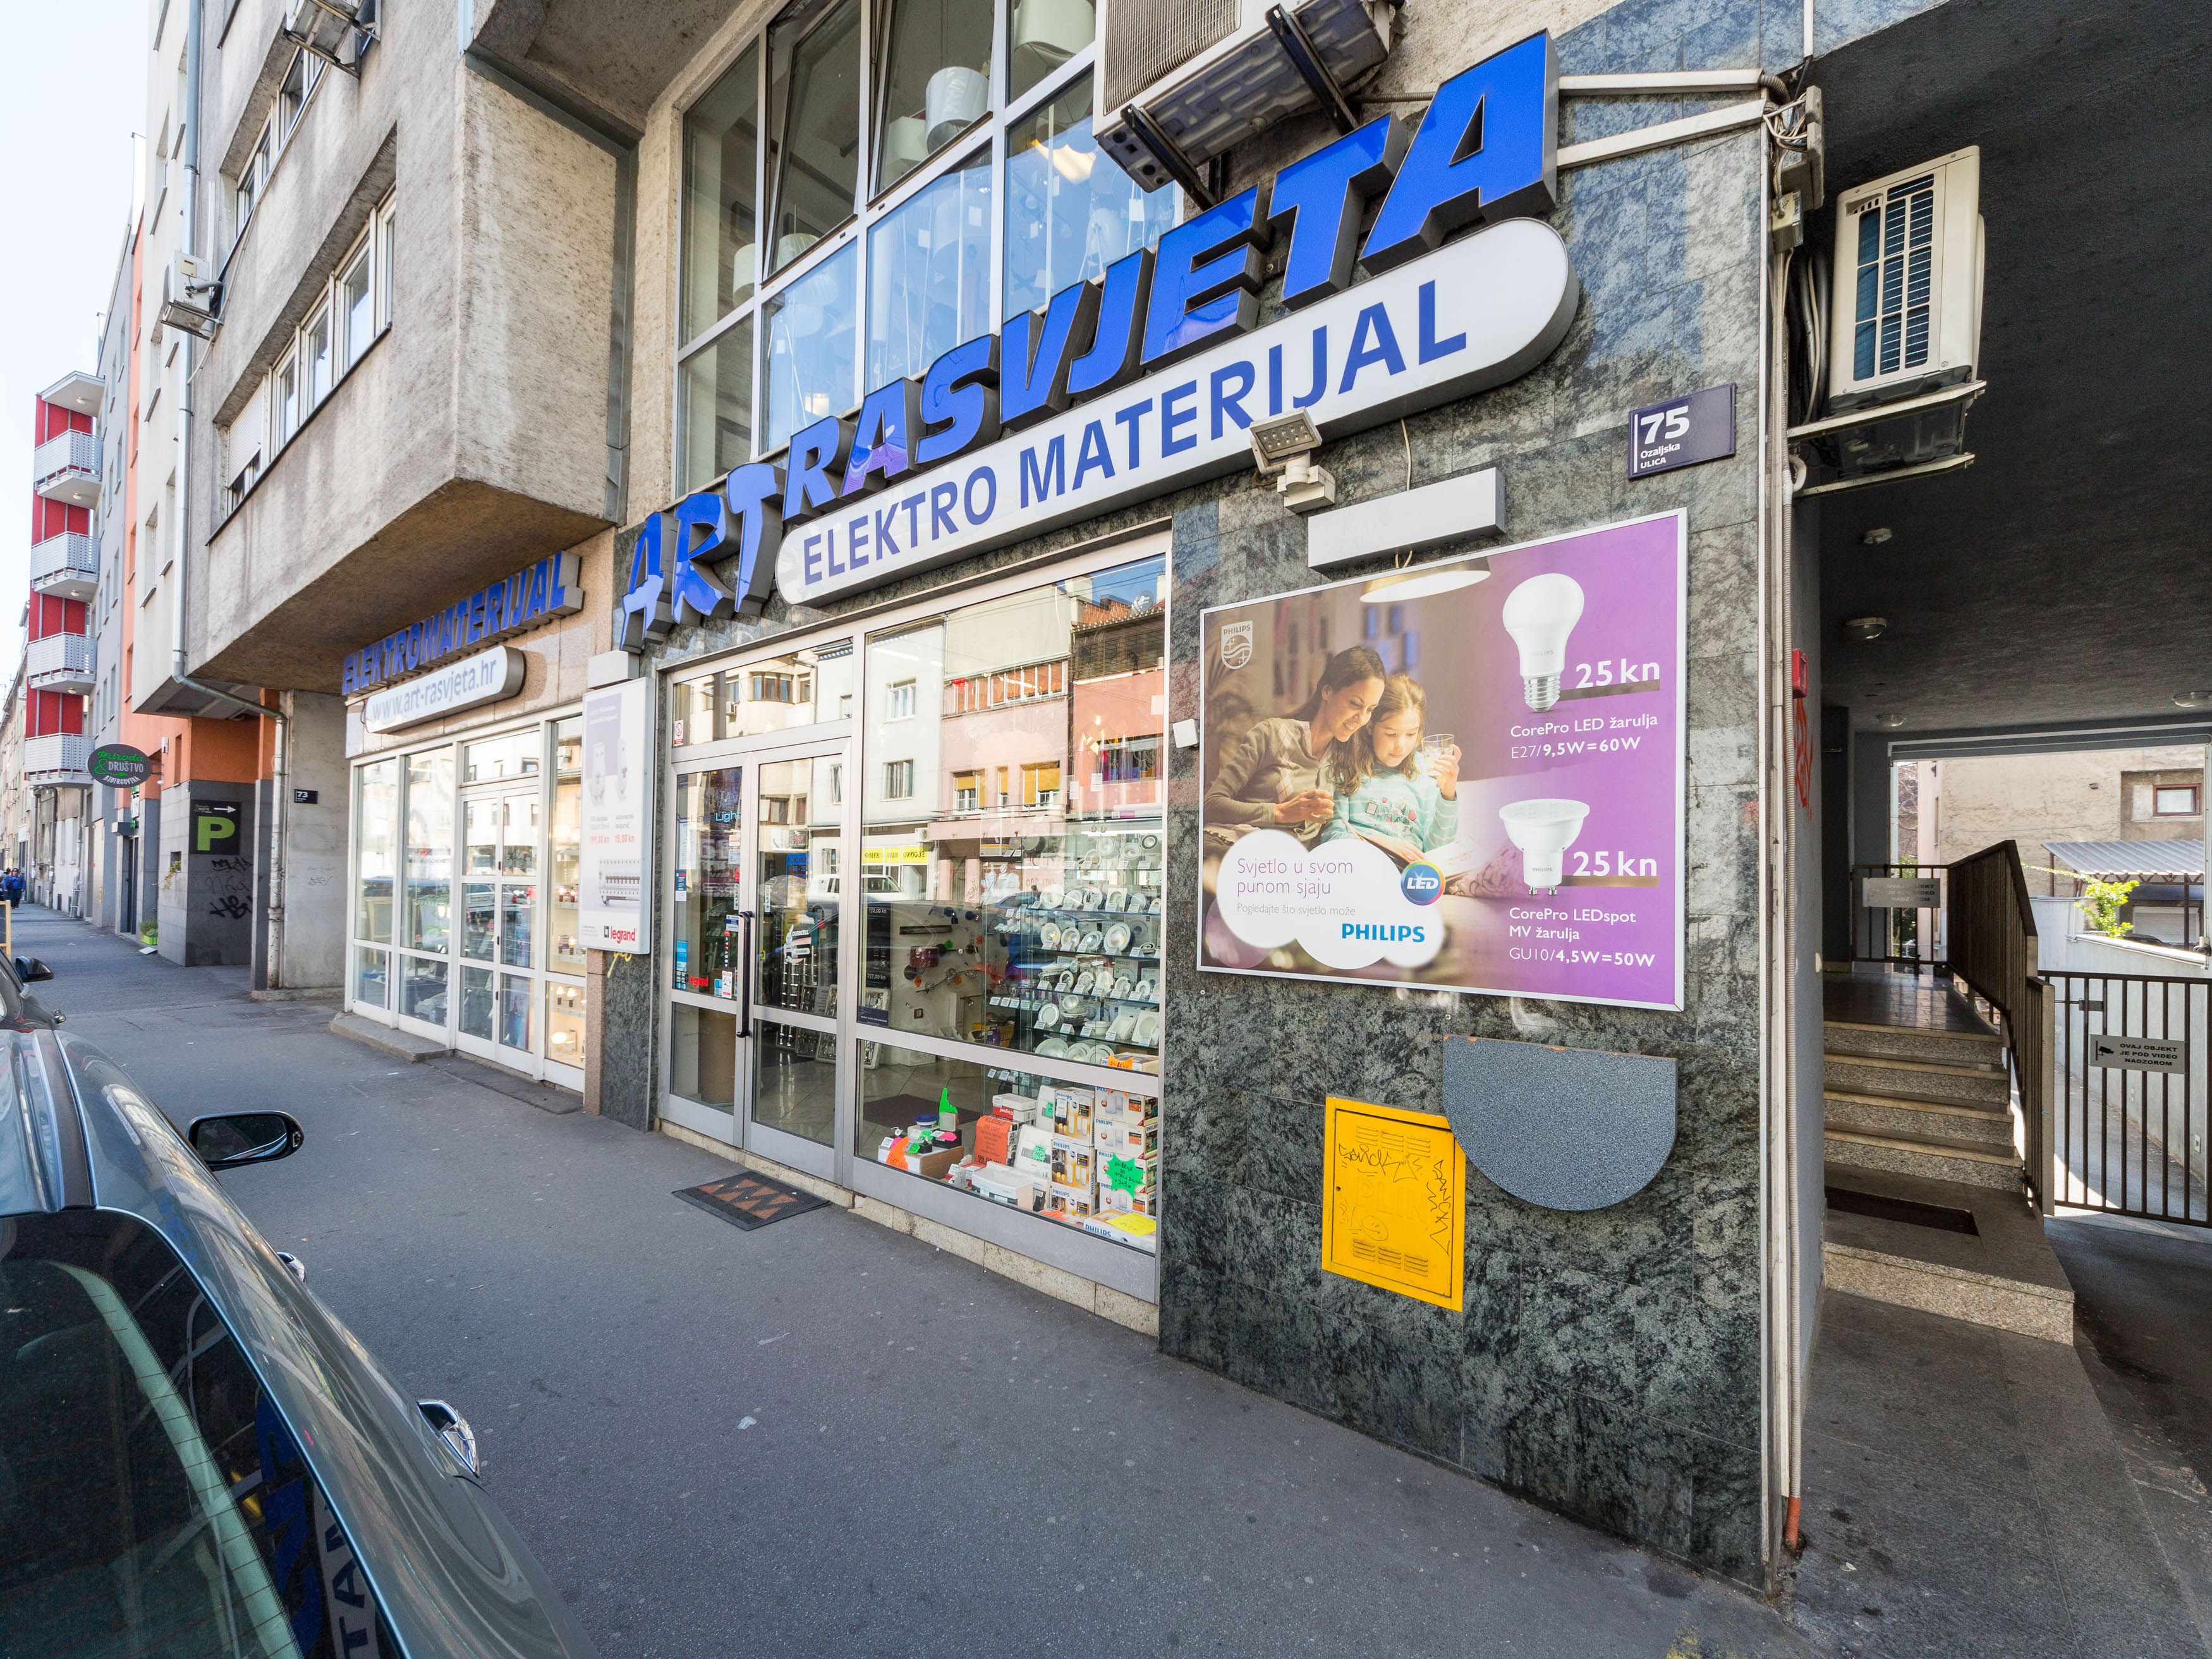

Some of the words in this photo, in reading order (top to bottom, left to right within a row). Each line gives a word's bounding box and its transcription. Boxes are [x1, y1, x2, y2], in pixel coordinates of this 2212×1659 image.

[620, 463, 784, 652] ART
[782, 29, 1557, 521] RASVJETA
[804, 466, 997, 585] ELEKTRO
[1021, 280, 1467, 509] MATERIJAL
[1641, 405, 1689, 444] 75
[1641, 443, 1680, 459] Ozaljska
[1641, 457, 1667, 468] ULICA
[342, 551, 578, 695] ELEKTROMATERIJAL
[1224, 624, 1251, 636] PHILIPS
[1576, 660, 1613, 689] 25
[1620, 659, 1660, 684] kn
[372, 657, 497, 720] www.art-rasvjeta.hr
[1510, 722, 1569, 738] CorePro
[1574, 718, 1604, 732] LED
[1609, 713, 1659, 729] žarulja
[97, 750, 144, 762] Priroda
[108, 760, 144, 773] DRUŠTVO
[103, 775, 141, 785] BIOTRGOVINA
[197, 816, 235, 851] P
[1237, 858, 1287, 878] Svjetlo
[1294, 862, 1303, 874] u
[1310, 860, 1353, 874] svom
[1573, 851, 1610, 877] 25
[1618, 851, 1658, 877] kn
[1237, 880, 1290, 897] punom
[1296, 879, 1331, 899] sjaju
[1406, 877, 1439, 890] LED
[1237, 902, 1280, 915] Pogledajte
[1282, 904, 1296, 914] što
[1297, 904, 1327, 916] svjetlo
[1329, 906, 1356, 916] može
[1509, 907, 1568, 921] CorePro
[1573, 909, 1636, 925] LEDspot
[610, 925, 636, 944] legrand
[1342, 923, 1425, 942] PHILIPS
[1509, 925, 1532, 937] MV
[1536, 926, 1580, 942] žarulja
[689, 974, 708, 988] legrand
[2124, 1058, 2173, 1066] NADZOROM
[1053, 1141, 1071, 1150] PHILIPS
[1052, 1188, 1070, 1198] PHILIPS
[1085, 1224, 1112, 1237] PHILIPS
